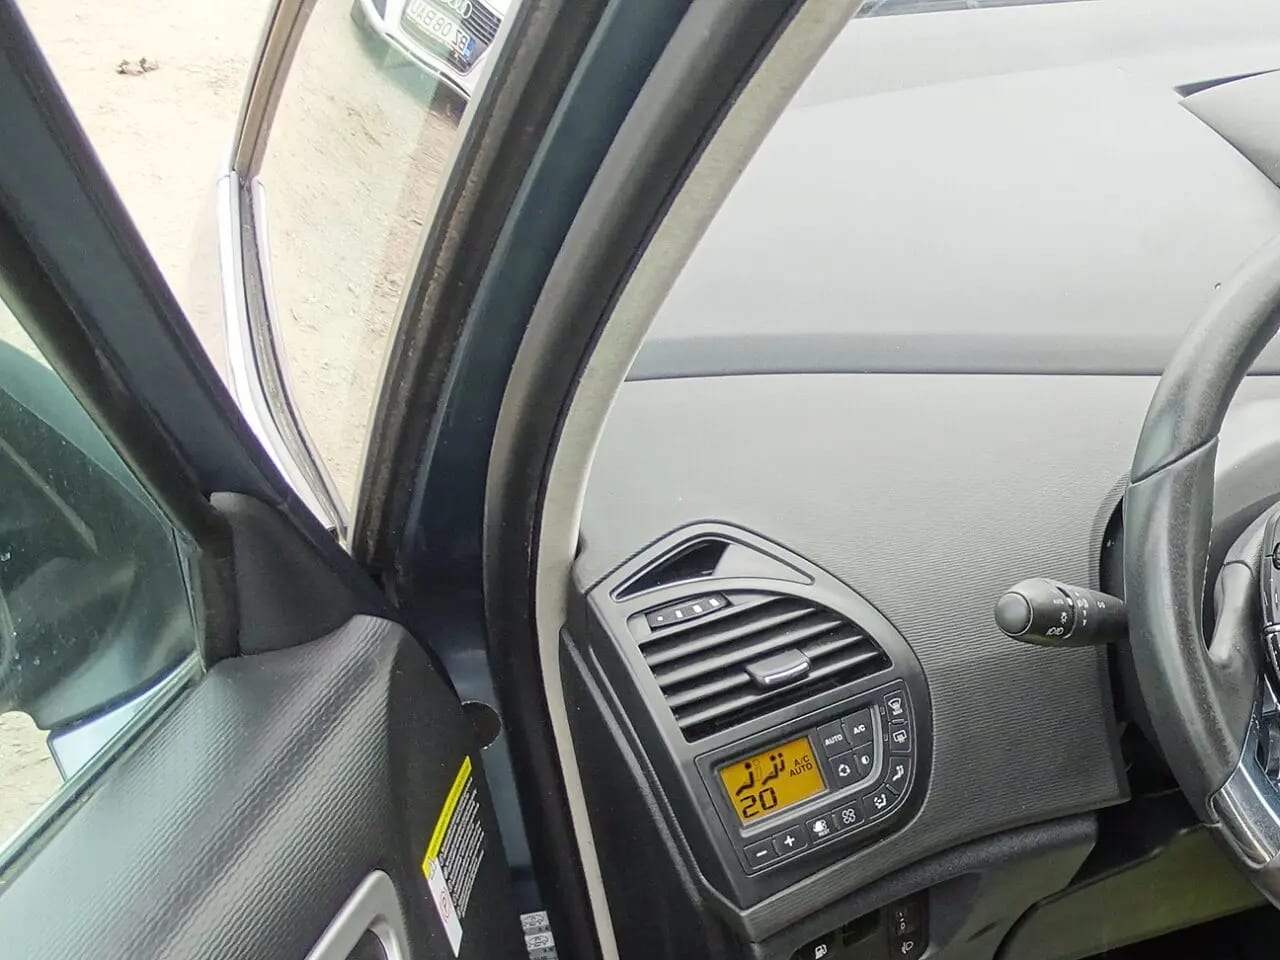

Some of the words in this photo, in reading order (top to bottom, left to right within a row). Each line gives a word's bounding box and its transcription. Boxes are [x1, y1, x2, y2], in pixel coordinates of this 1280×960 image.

[853, 724, 866, 735] A/C
[825, 734, 843, 746] AUTO
[794, 754, 810, 766] A/C
[789, 762, 813, 778] AUTO
[740, 787, 778, 819] 20
